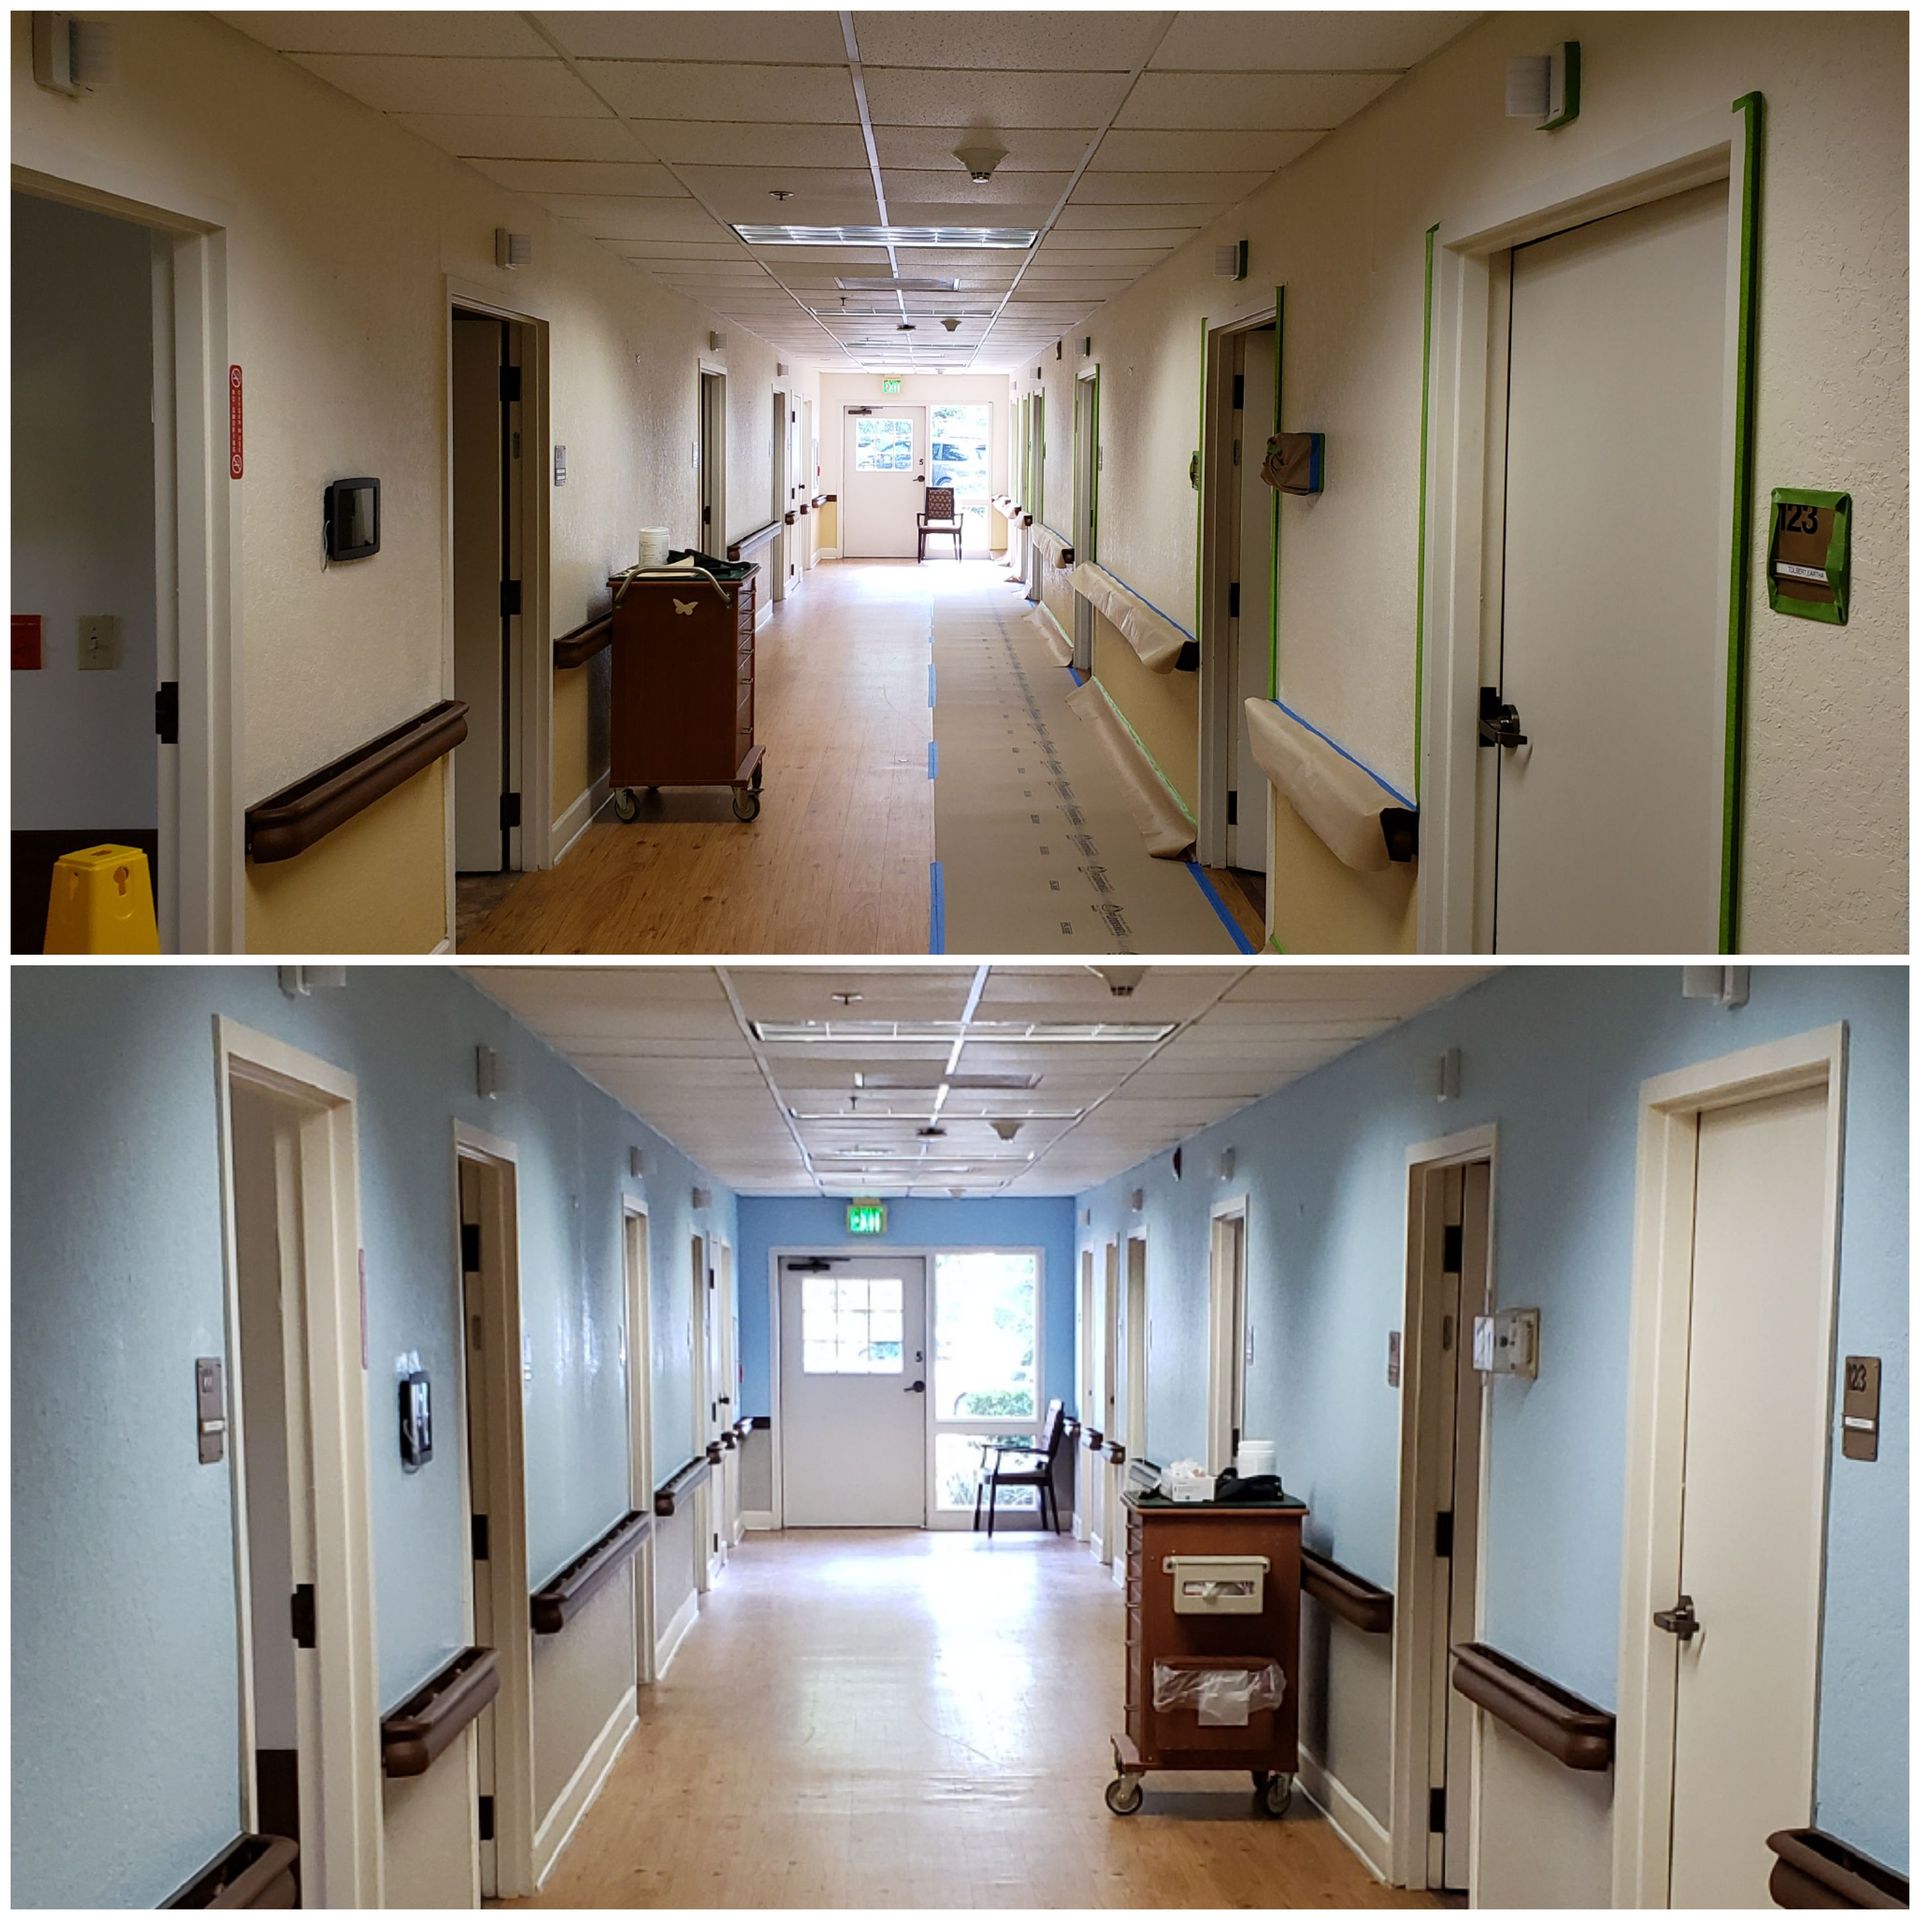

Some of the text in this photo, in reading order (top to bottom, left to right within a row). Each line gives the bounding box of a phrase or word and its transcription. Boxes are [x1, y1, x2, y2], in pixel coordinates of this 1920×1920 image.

[883, 379, 901, 393] EXIT
[1779, 503, 1818, 535] 123
[850, 1207, 880, 1232] EXIT
